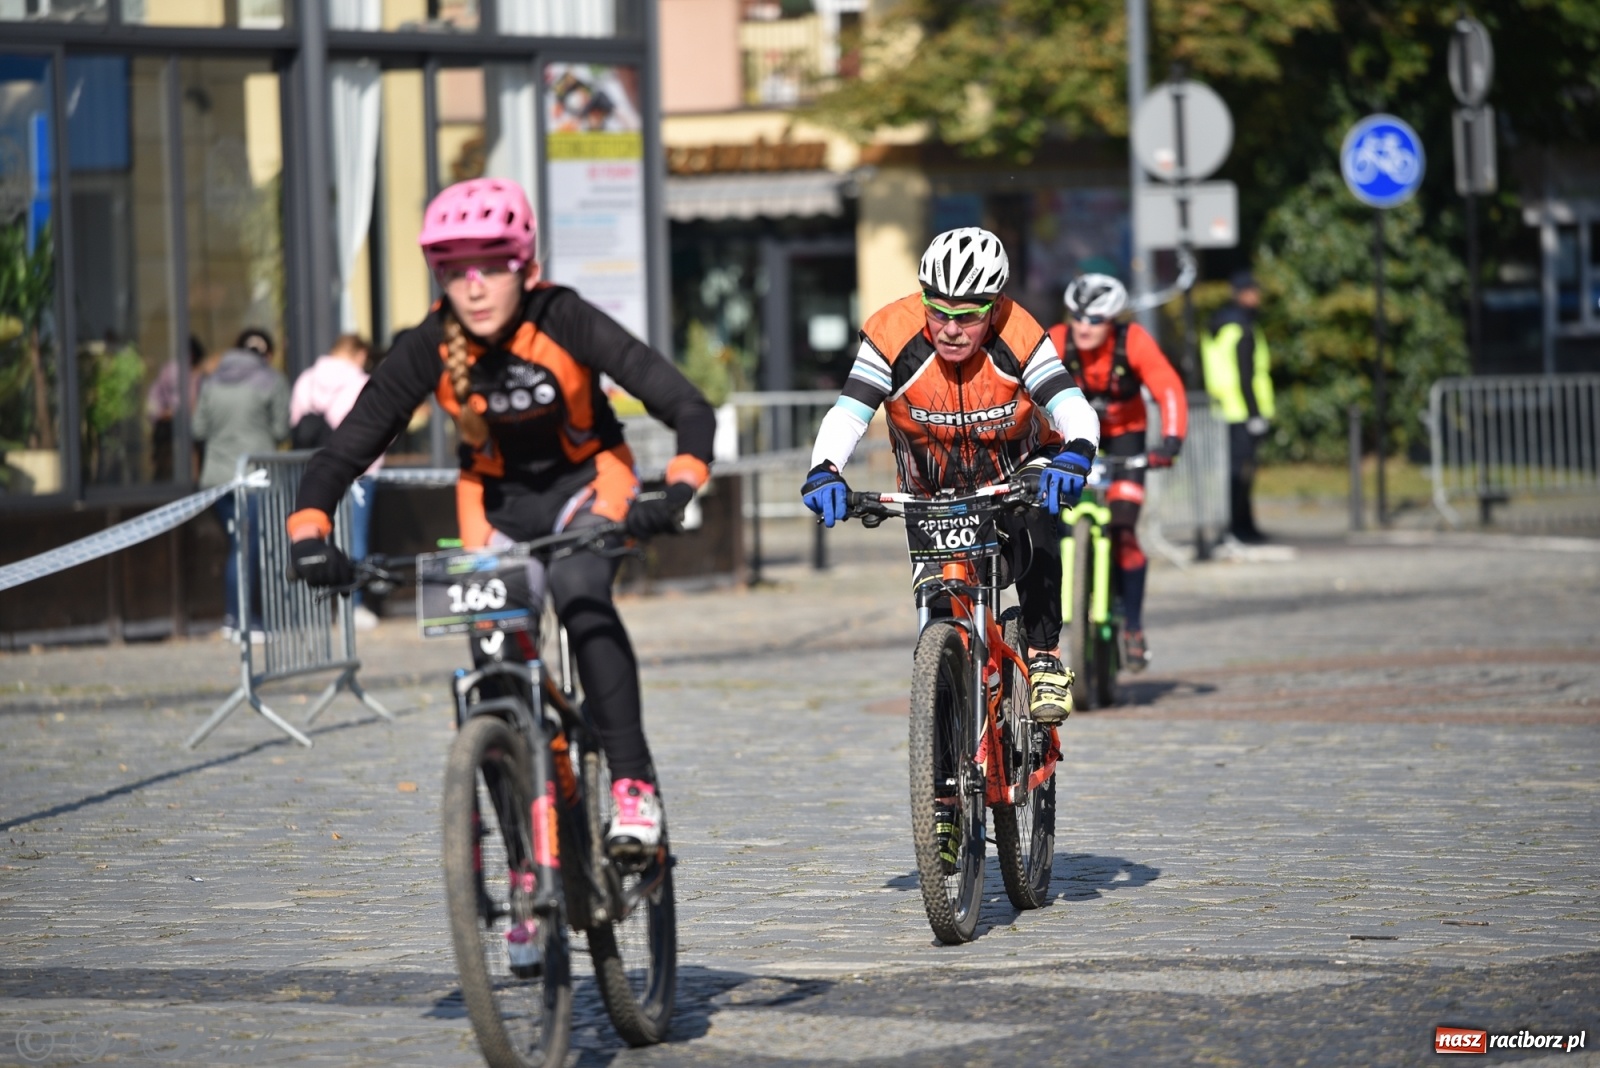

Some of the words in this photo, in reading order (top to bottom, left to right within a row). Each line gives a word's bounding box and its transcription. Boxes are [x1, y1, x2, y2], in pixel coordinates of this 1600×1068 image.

[966, 267, 979, 284] uvex
[976, 420, 1016, 433] team
[917, 514, 980, 531] OPIEKUN
[930, 527, 976, 550] 160
[447, 578, 507, 613] 160
